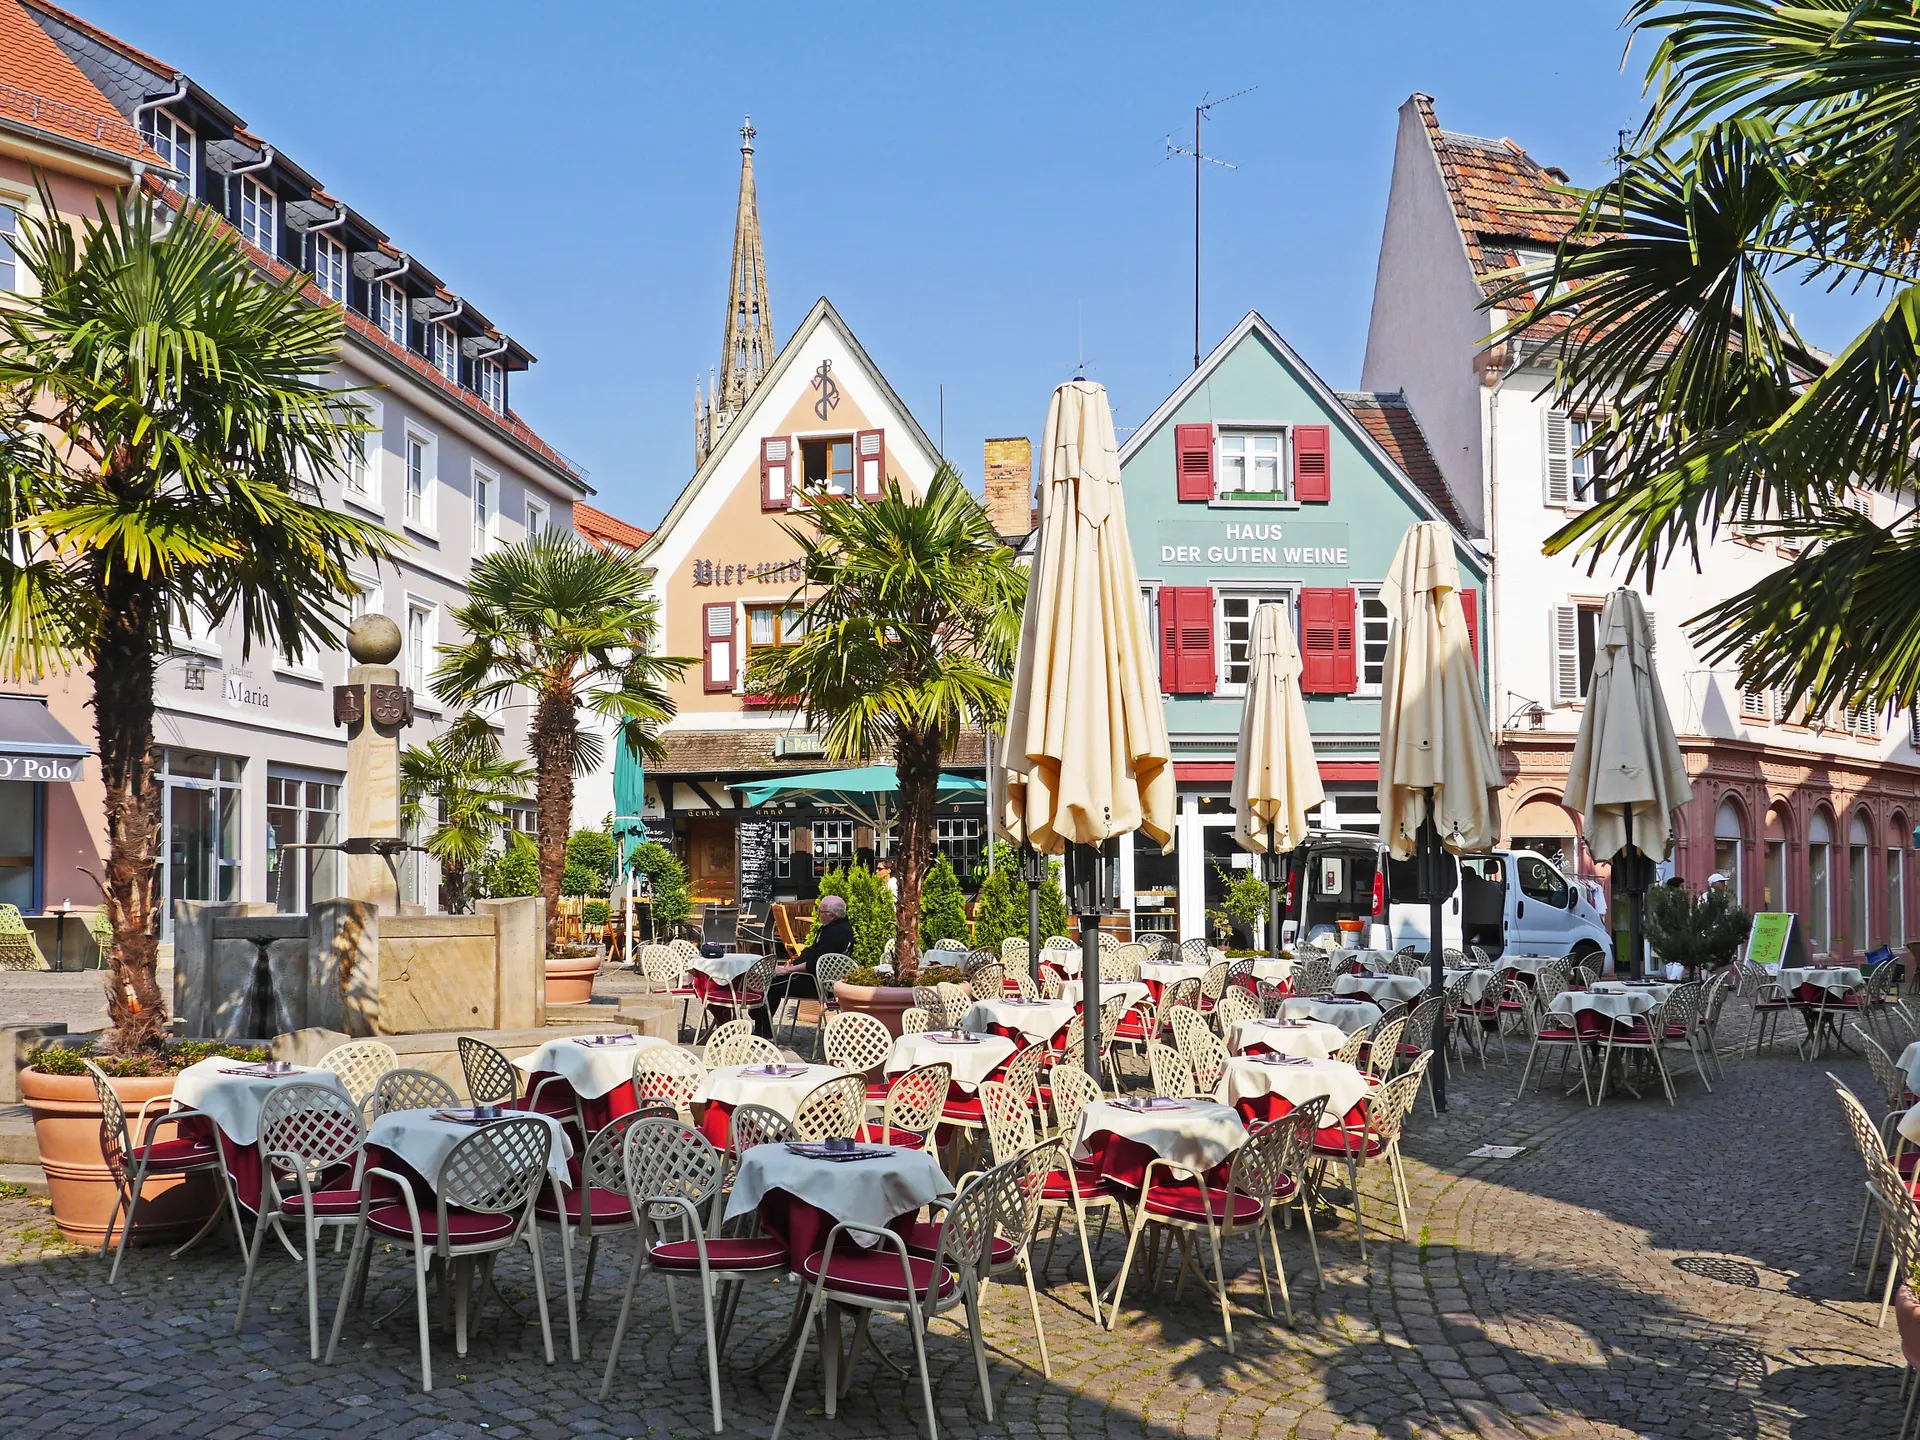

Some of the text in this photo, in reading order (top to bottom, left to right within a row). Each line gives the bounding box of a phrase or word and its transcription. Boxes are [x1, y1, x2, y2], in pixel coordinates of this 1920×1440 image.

[1226, 523, 1283, 541] HAUS
[1161, 545, 1348, 564] DER GUTEN WEINE
[229, 663, 254, 679] Atelier
[228, 679, 269, 708] Maria
[687, 808, 721, 817] Tenne
[755, 808, 783, 816] anno
